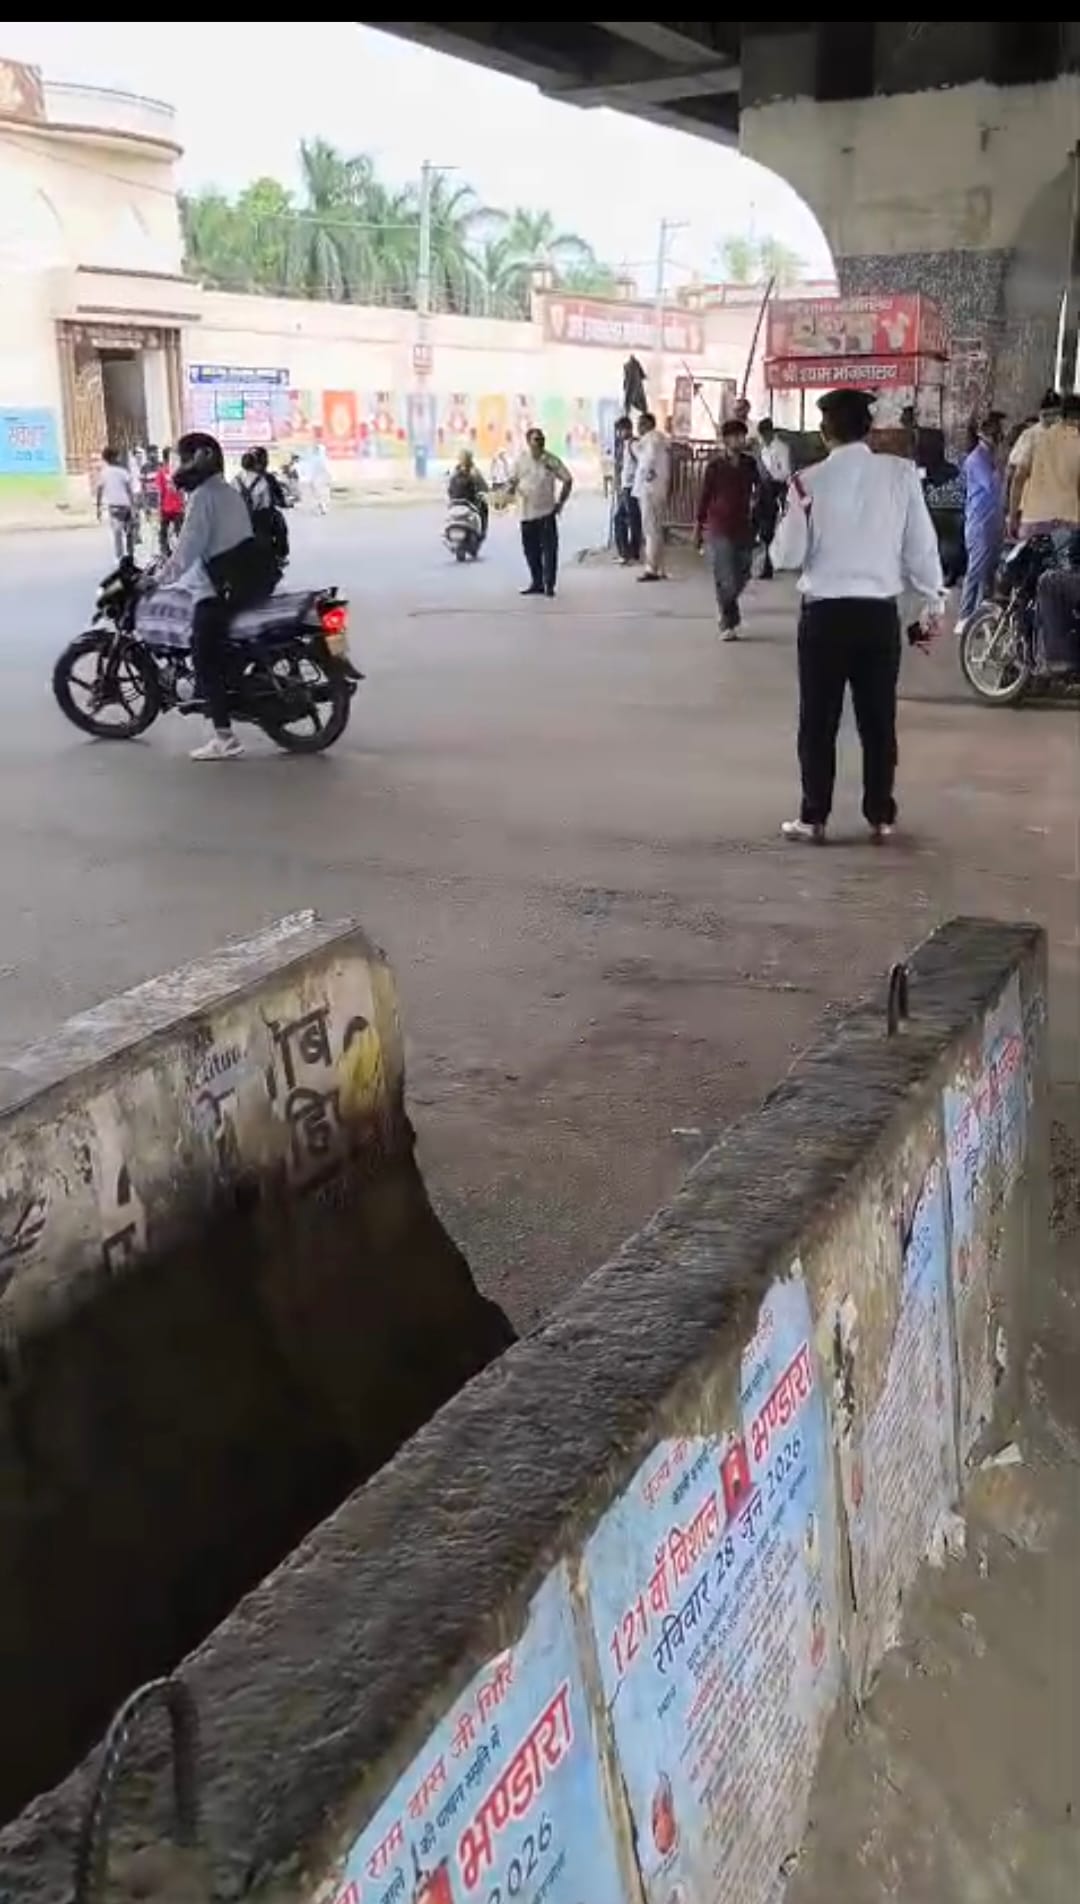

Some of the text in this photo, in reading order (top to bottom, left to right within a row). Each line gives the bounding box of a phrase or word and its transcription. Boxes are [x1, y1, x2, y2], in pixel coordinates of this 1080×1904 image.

[609, 1594, 647, 1674] 121
[666, 1490, 719, 1592] विशाल
[750, 1340, 811, 1463] भण्डारा
[652, 1570, 710, 1674] रविवार
[713, 1534, 734, 1586] 28
[738, 1488, 763, 1543] जून
[459, 1681, 571, 1890] भण्डारा
